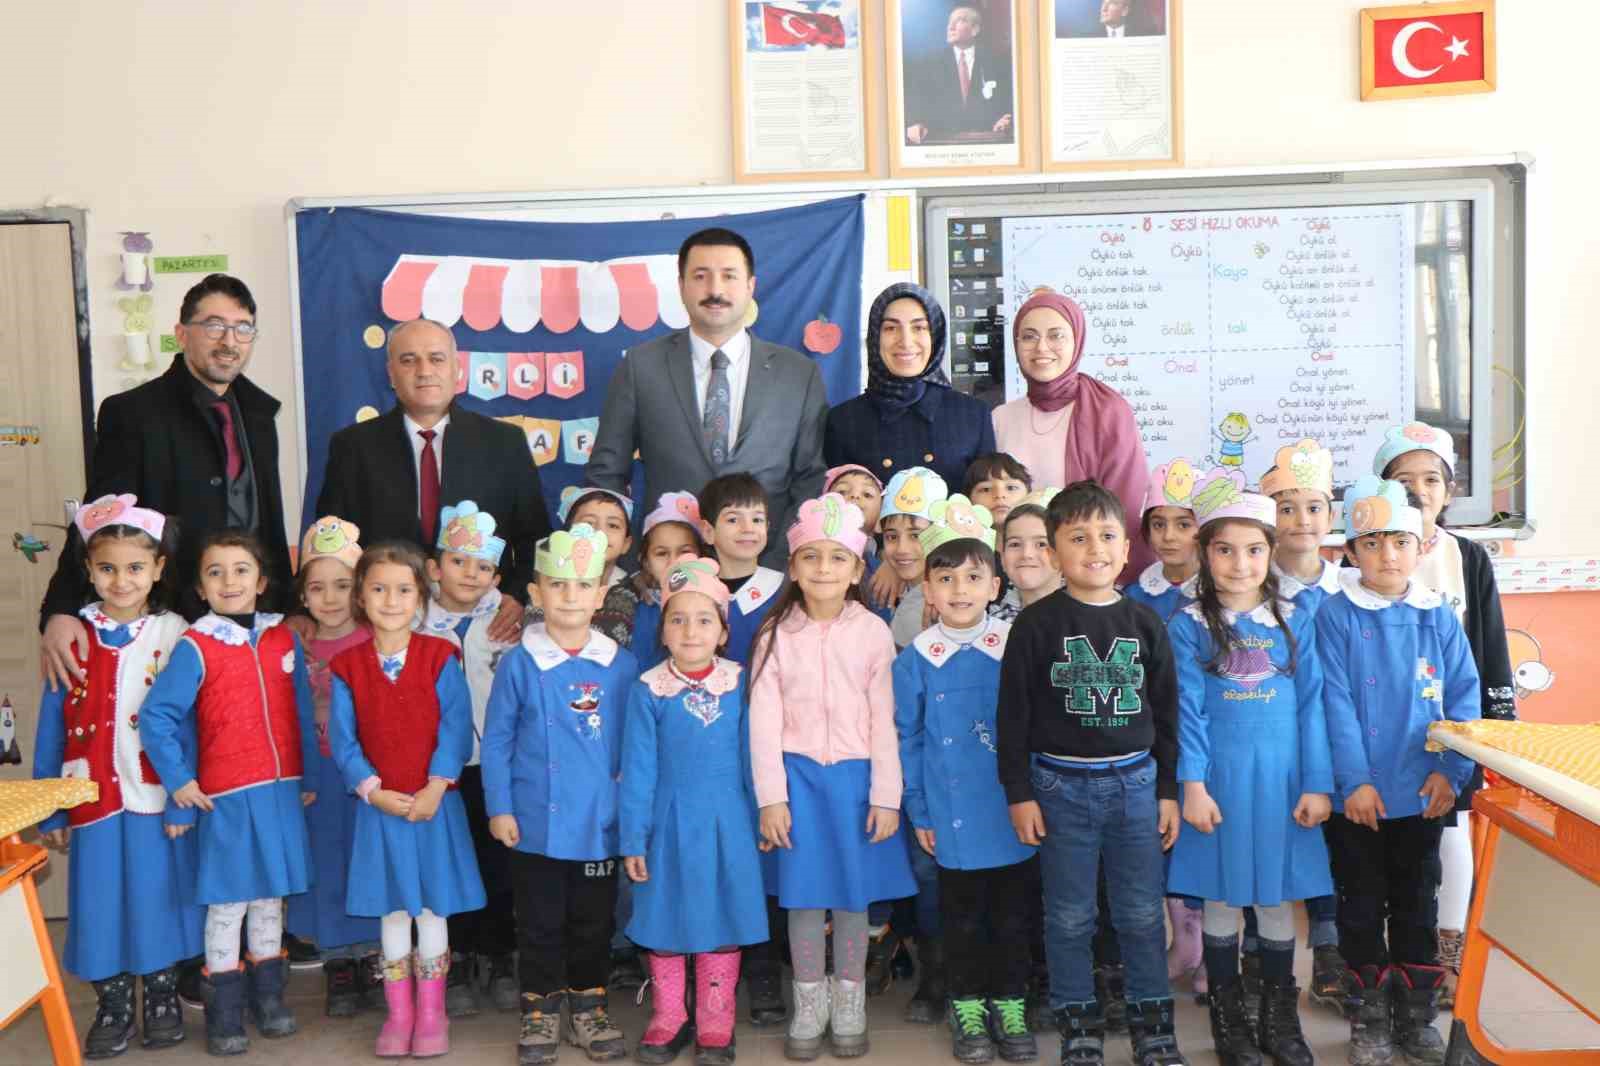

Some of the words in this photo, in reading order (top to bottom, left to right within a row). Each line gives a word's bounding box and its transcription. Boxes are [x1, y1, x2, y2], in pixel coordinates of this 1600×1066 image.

[1170, 241, 1203, 262] Öykü
[1164, 354, 1198, 374] Önal
[584, 859, 616, 877] GAP
